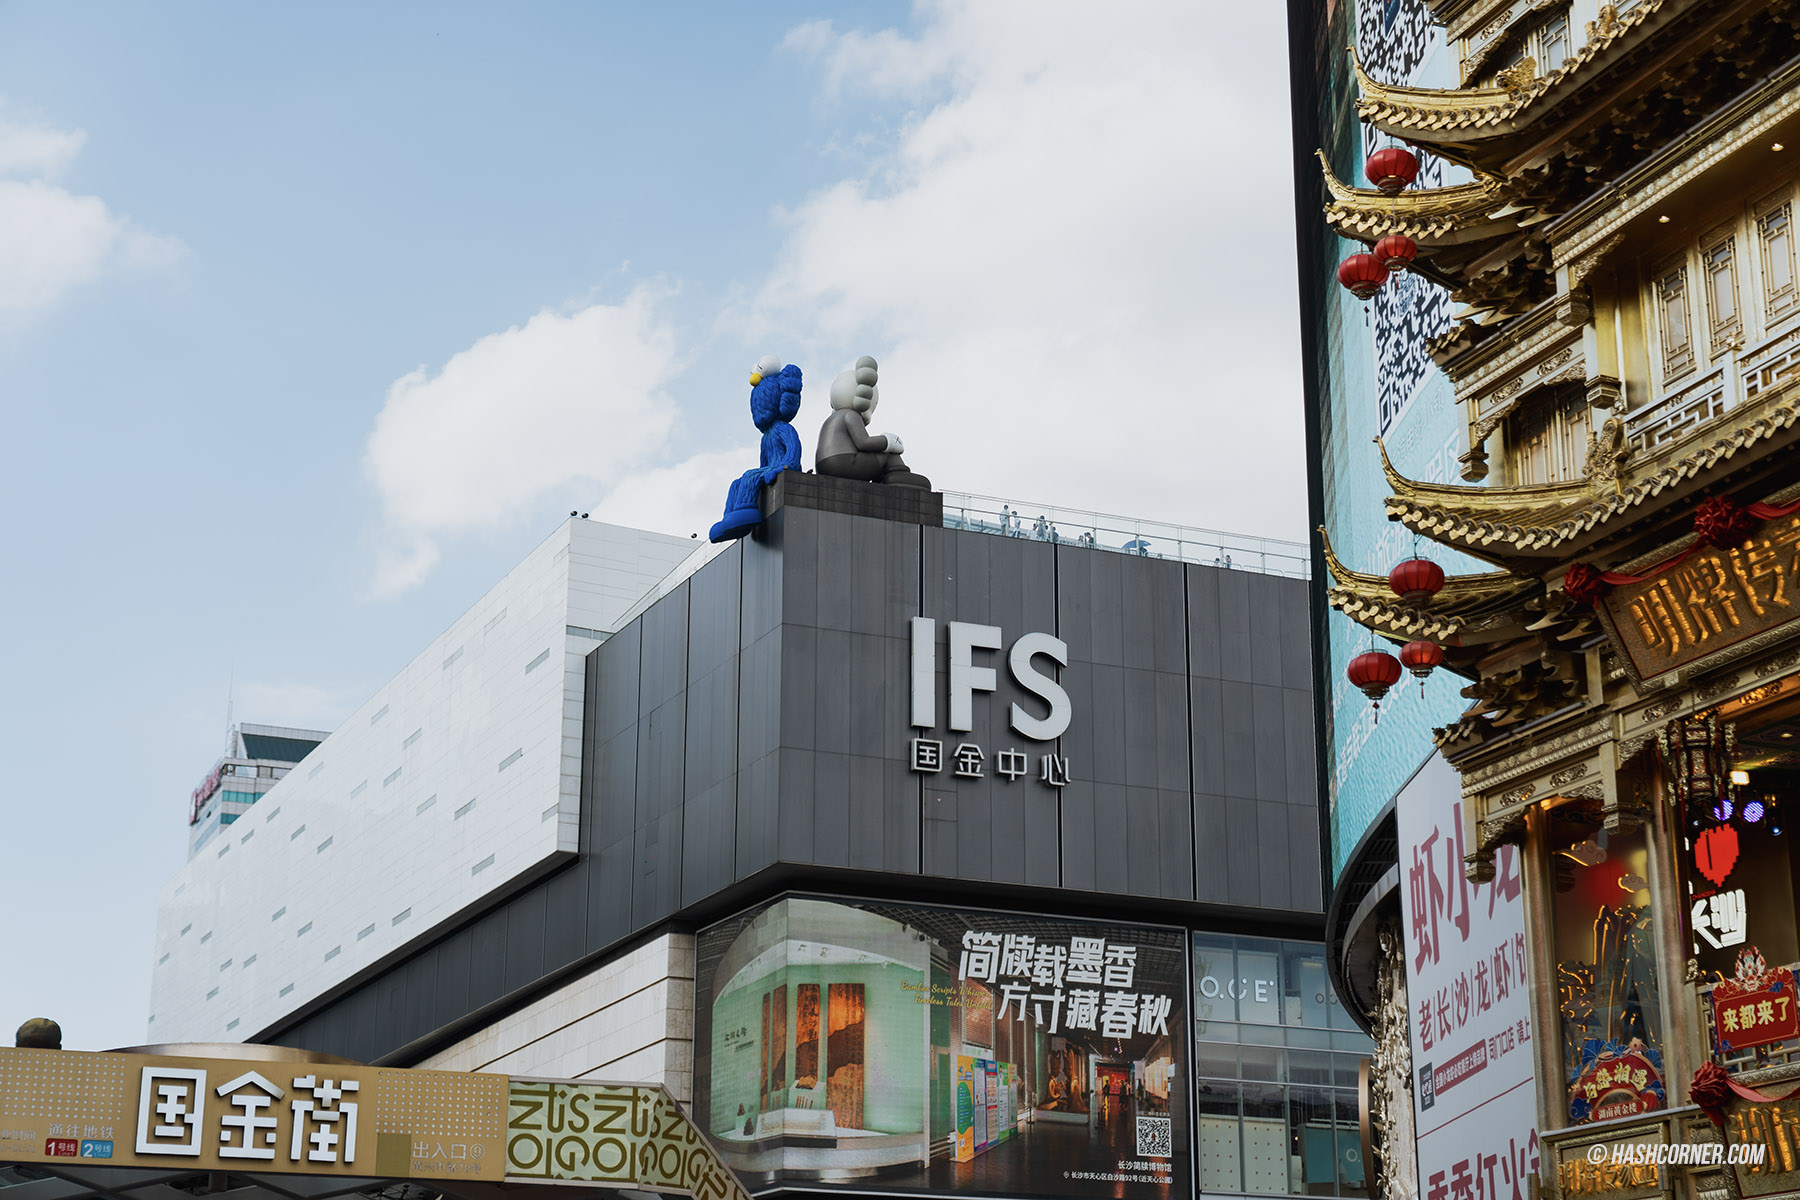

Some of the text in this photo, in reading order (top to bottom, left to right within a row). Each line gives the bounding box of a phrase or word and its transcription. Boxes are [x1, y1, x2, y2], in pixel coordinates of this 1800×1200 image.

[911, 616, 1072, 741] IFS
[911, 738, 1072, 786] 国金中心
[958, 930, 1137, 988] 简牍载墨香
[931, 984, 957, 996] Scripts
[997, 981, 1172, 1040] 方寸藏春秋
[1722, 996, 1790, 1033] 来都来了
[48, 1123, 115, 1139] 通往地铁
[136, 1066, 360, 1162] 国金街
[1118, 1160, 1172, 1173] 长沙简牍博物馆
